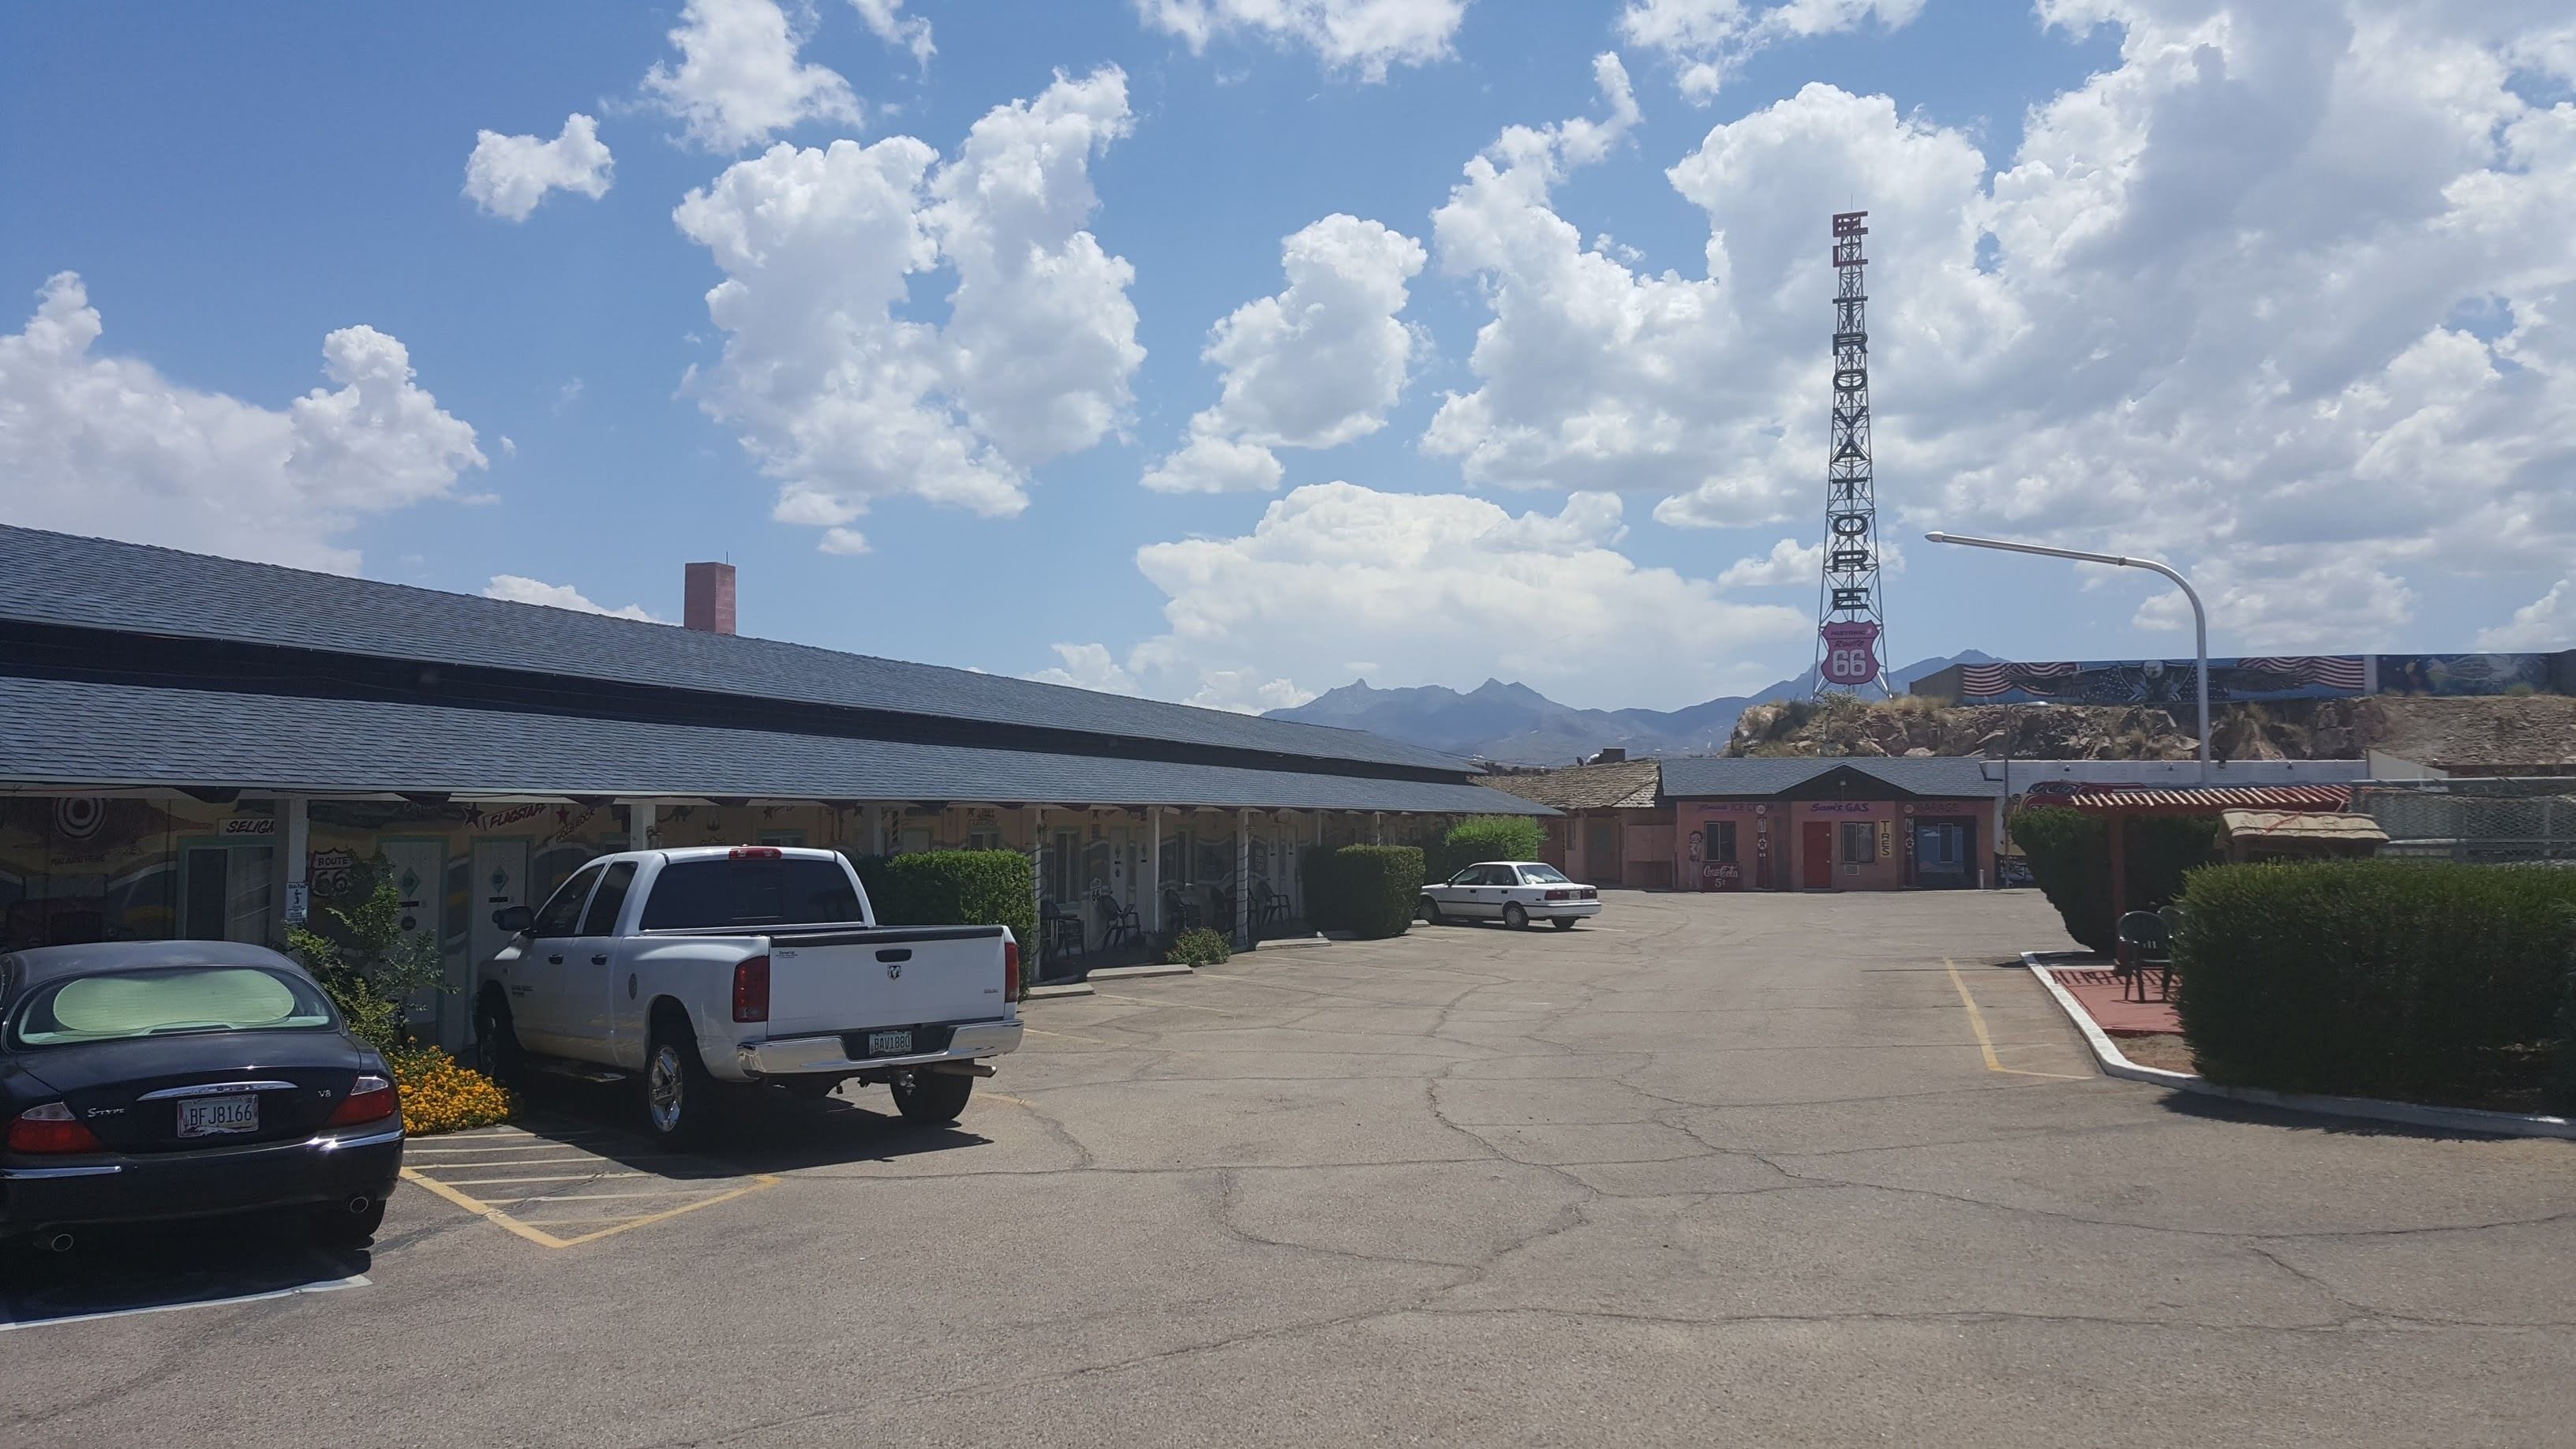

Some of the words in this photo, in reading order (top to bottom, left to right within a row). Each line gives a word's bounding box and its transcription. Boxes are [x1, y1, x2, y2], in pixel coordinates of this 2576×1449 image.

[1833, 649, 1866, 676] 66
[489, 803, 547, 829] FLAGSTAFF
[1810, 803, 1844, 812] Sam's
[1846, 803, 1870, 812] GAS
[1917, 803, 1958, 813] GARAGE
[1881, 820, 1891, 856] TIRES
[317, 856, 349, 867] ROUTE
[313, 870, 349, 895] 66
[189, 1105, 253, 1127] BFJ8166
